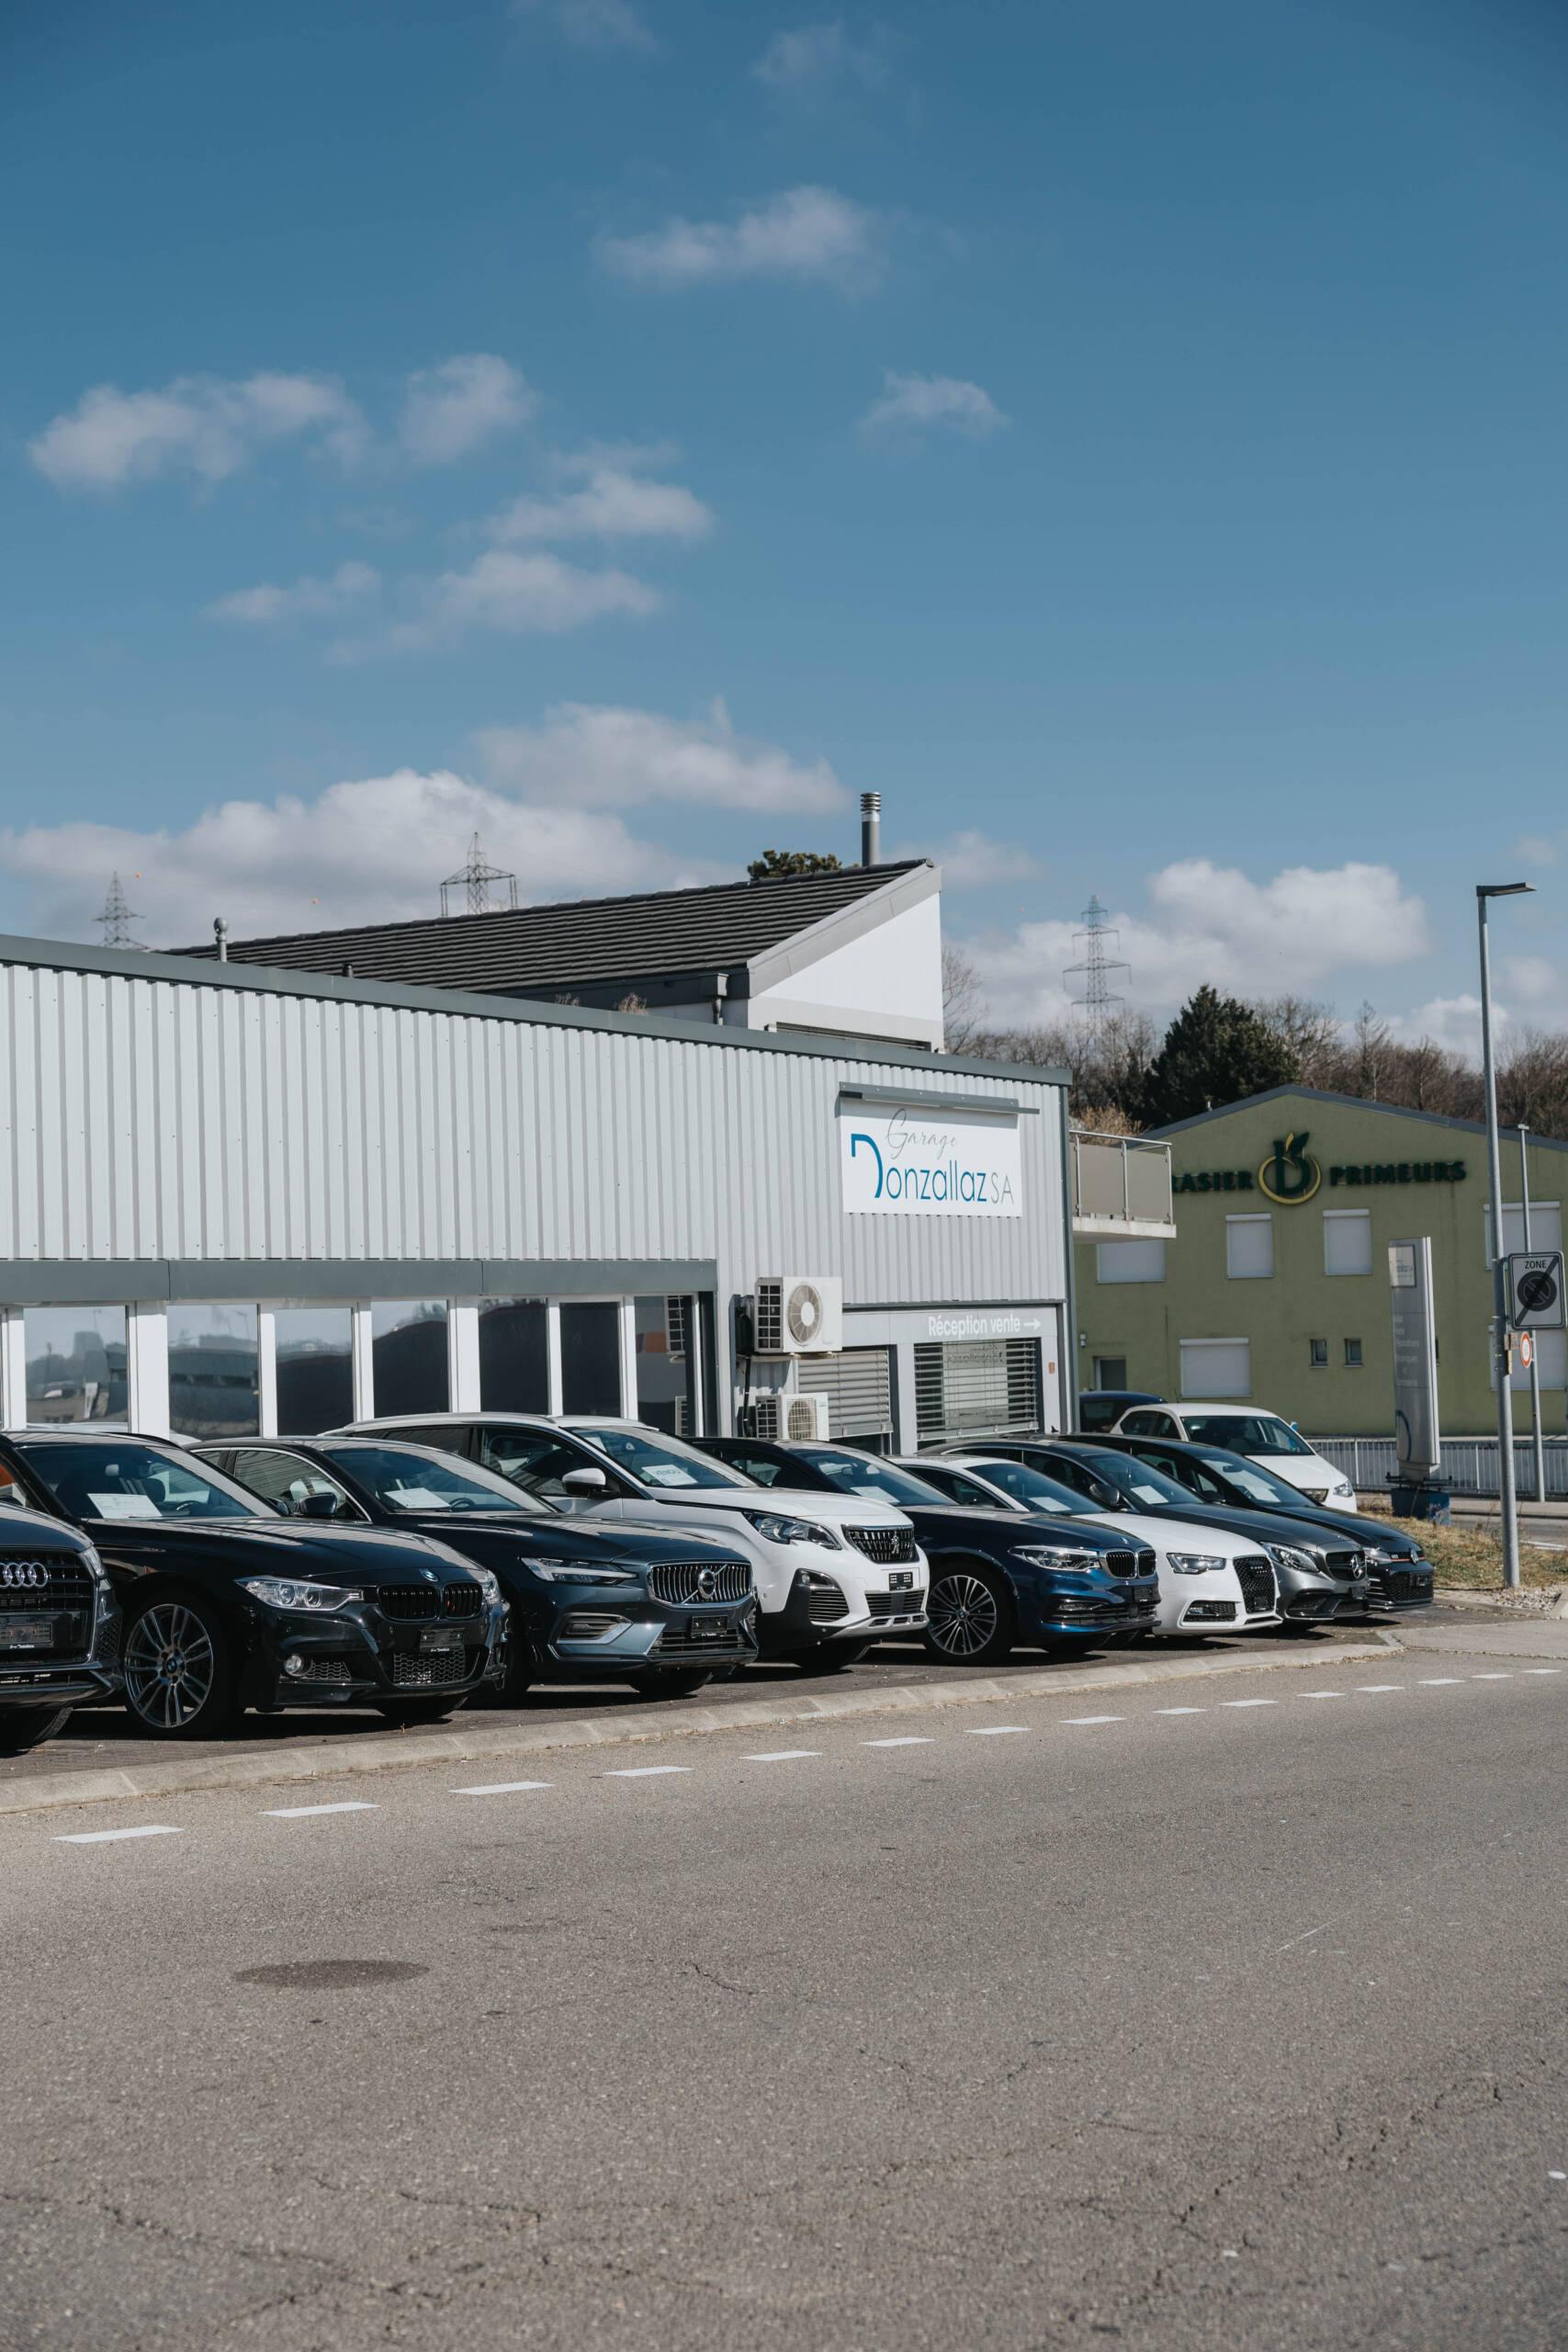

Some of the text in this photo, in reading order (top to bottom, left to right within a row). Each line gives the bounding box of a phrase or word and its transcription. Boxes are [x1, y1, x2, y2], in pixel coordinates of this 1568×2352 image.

[886, 1107, 957, 1160] Garage
[1329, 1160, 1466, 1186] PRIMEURS
[990, 1171, 1014, 1204] SA
[1524, 1260, 1547, 1270] ZONE
[929, 1314, 1021, 1339] Réception vente
